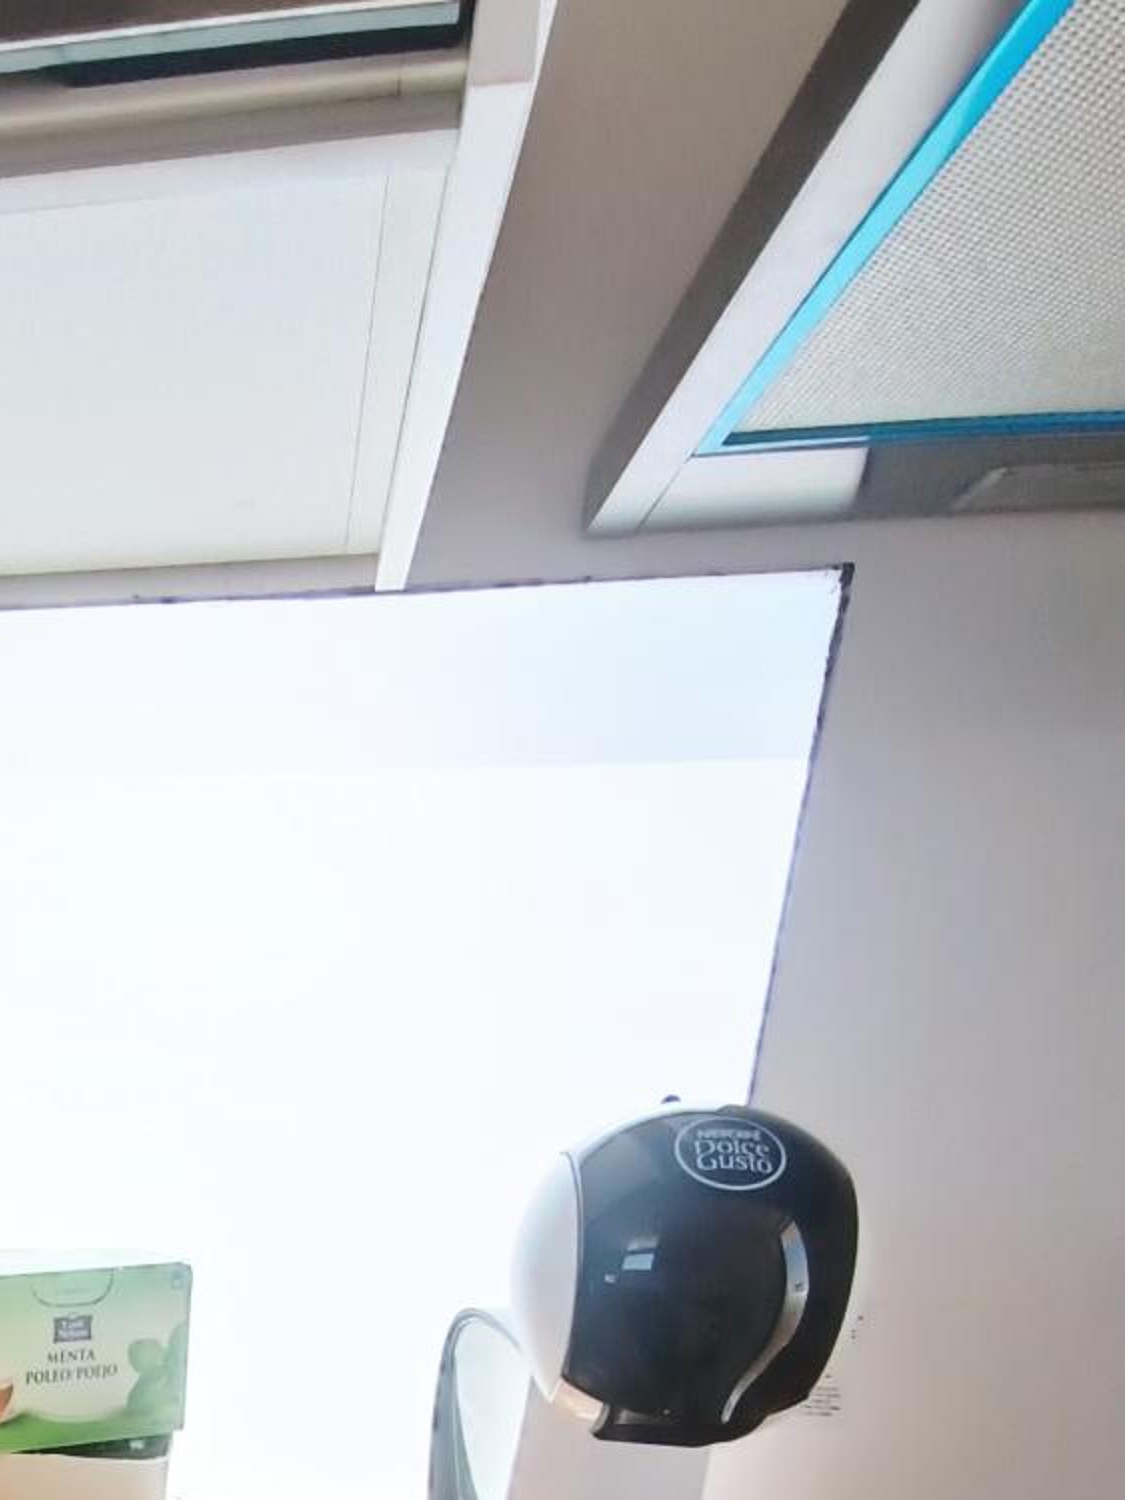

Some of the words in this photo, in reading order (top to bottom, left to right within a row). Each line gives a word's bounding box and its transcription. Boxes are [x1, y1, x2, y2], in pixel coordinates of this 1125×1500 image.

[694, 1139, 771, 1158] Dolce
[696, 1153, 774, 1175] Gusto
[46, 1349, 96, 1363] MENTA
